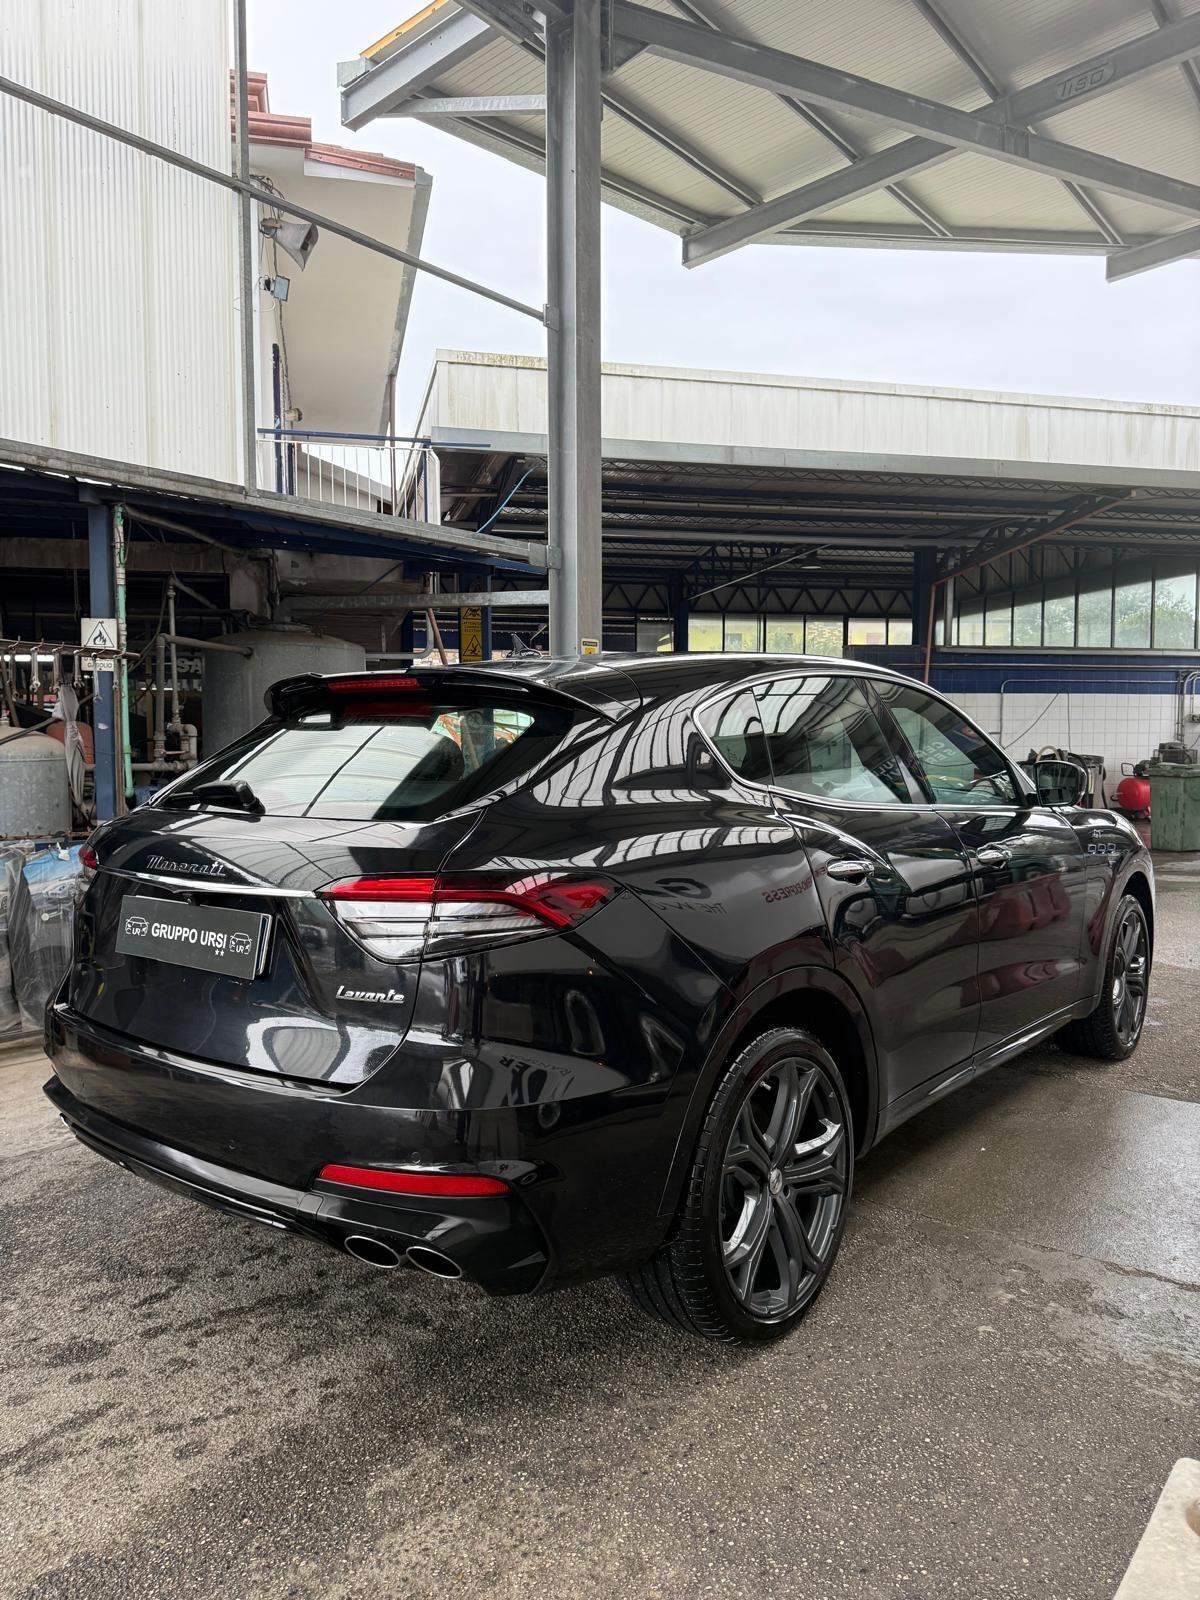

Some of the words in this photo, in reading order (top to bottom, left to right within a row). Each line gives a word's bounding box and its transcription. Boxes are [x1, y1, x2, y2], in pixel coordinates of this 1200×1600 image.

[146, 854, 226, 877] Maserati
[151, 922, 198, 944] GRUPPO
[200, 930, 228, 949] URSI
[335, 985, 405, 1005] Levante
